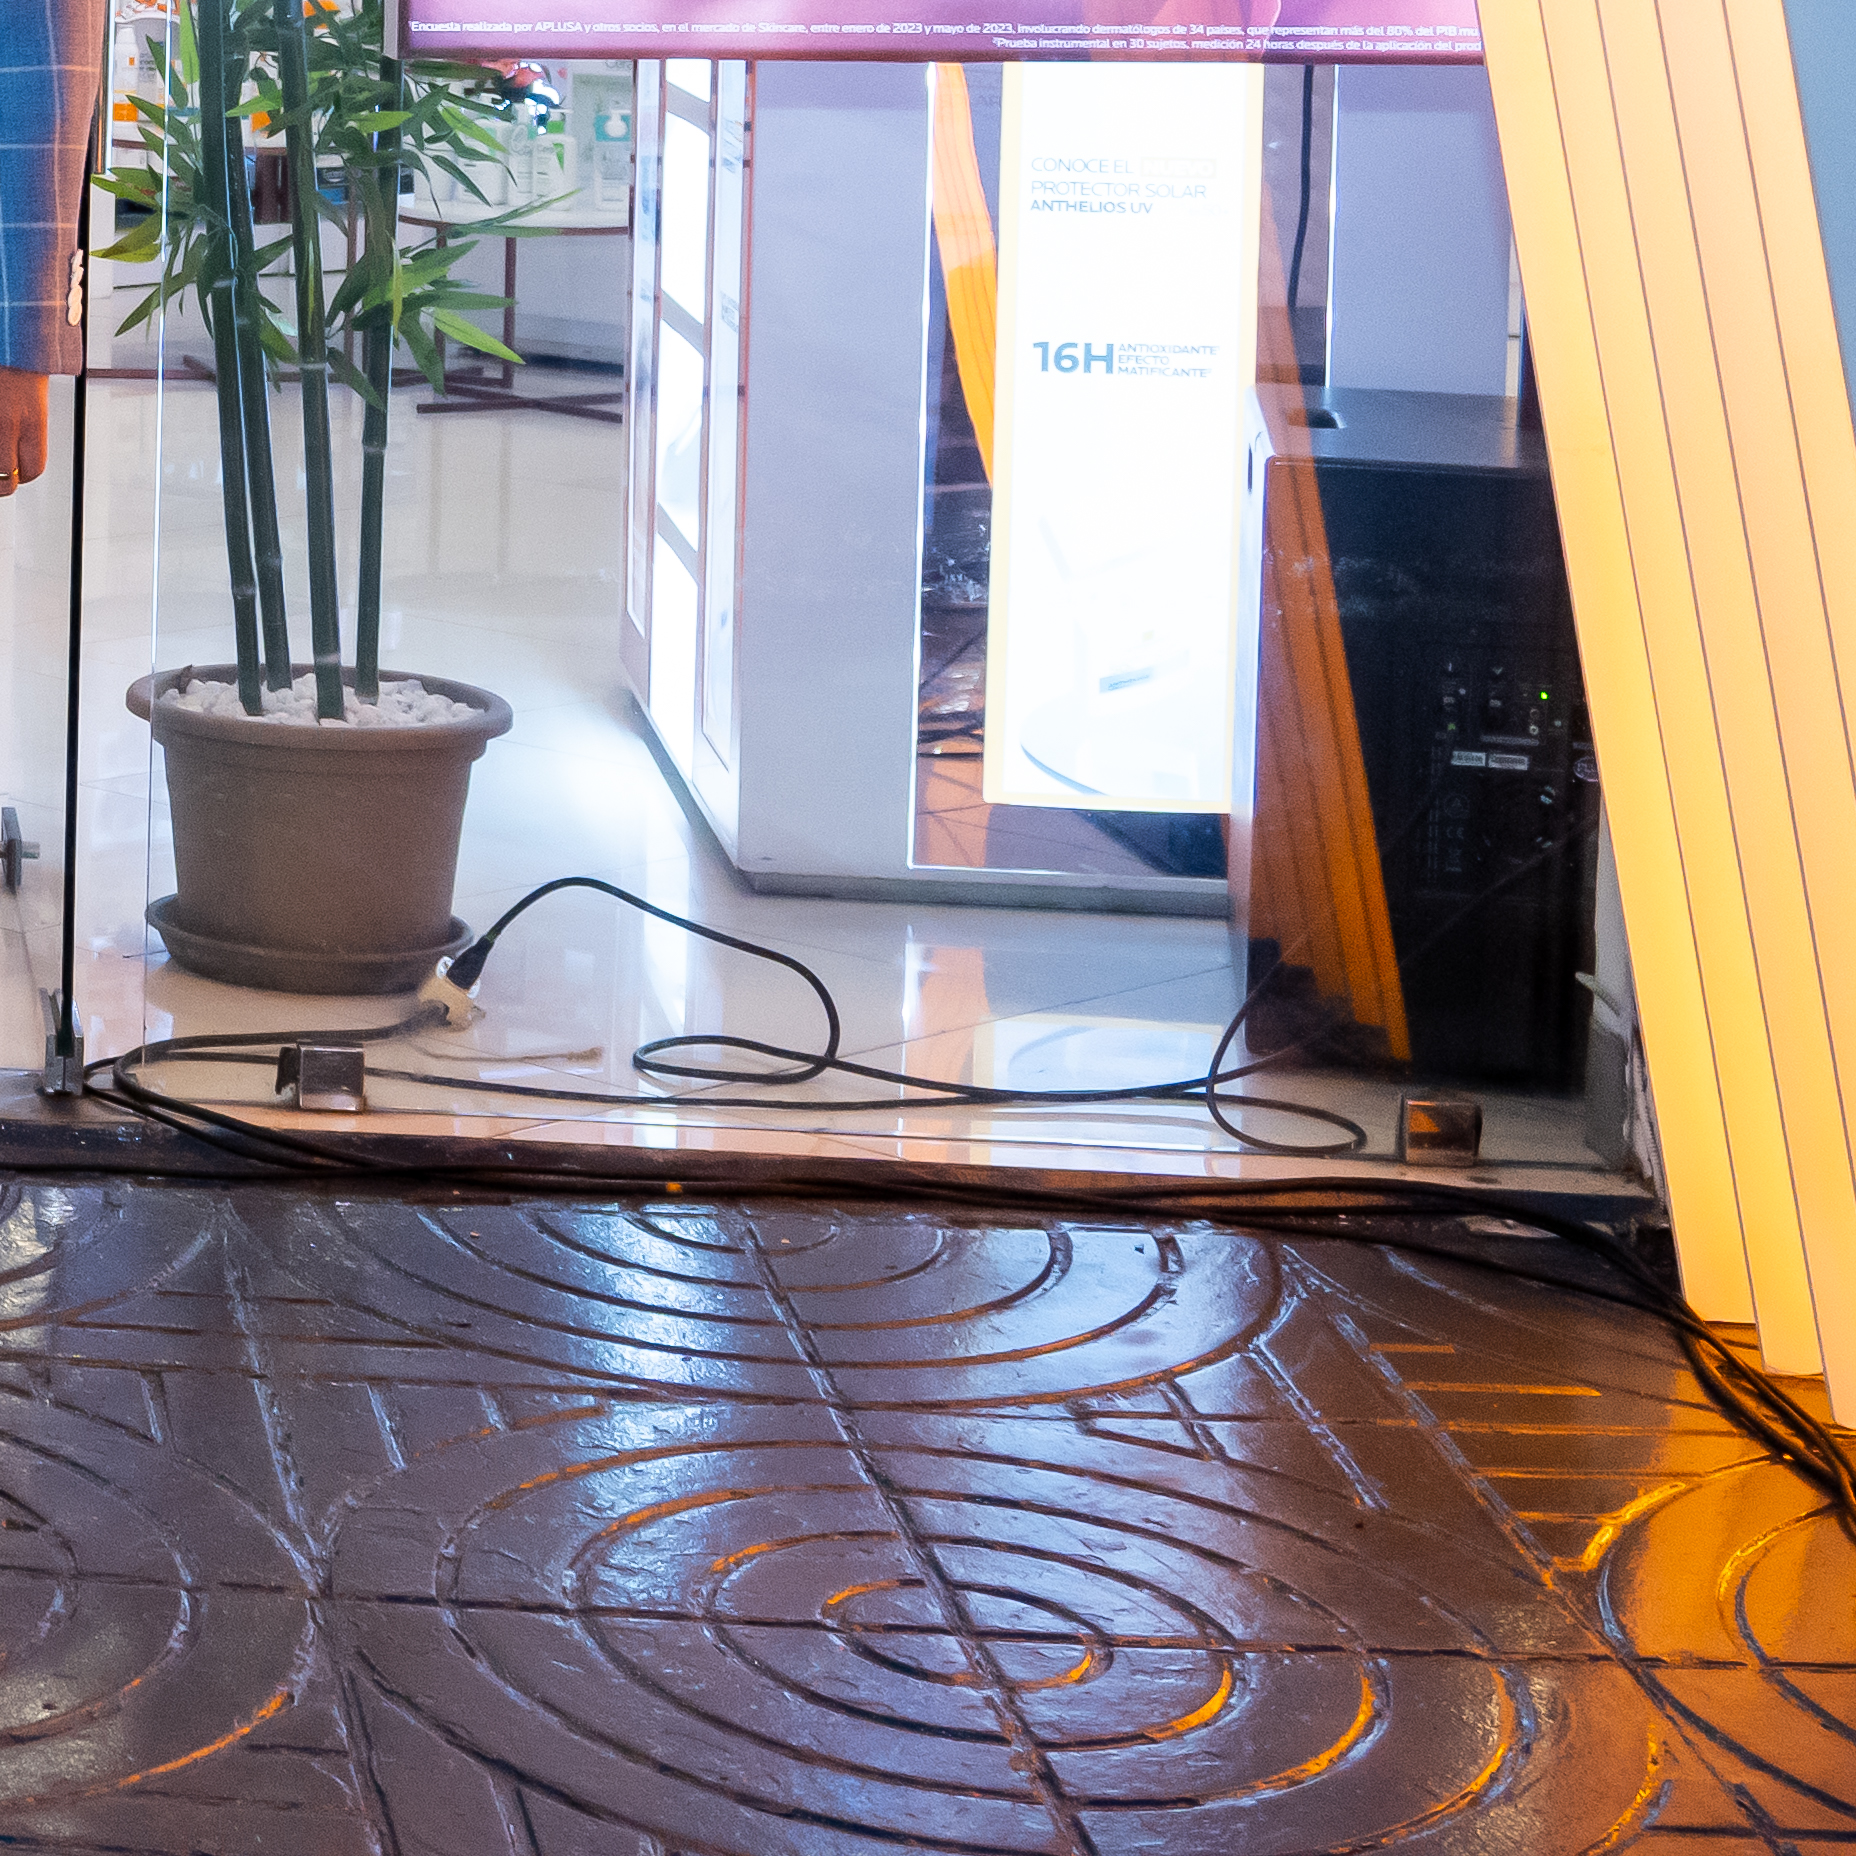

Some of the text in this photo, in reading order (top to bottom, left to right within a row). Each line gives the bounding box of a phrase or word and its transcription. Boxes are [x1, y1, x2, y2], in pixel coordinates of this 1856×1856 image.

[462, 21, 513, 32] realizada
[514, 23, 533, 34] por
[535, 21, 583, 33] APLUSA
[741, 23, 757, 33] de
[876, 23, 891, 33] de
[892, 23, 923, 34] 2023
[933, 25, 965, 35] mayo
[966, 24, 981, 34] de
[1172, 24, 1187, 35] de
[1189, 25, 1205, 35] 34
[1246, 27, 1270, 37] que
[1271, 26, 1339, 37] representan
[1366, 25, 1385, 36] del
[1415, 26, 1434, 36] del
[1039, 38, 1110, 49] instrumental
[1111, 40, 1127, 49] en
[1129, 38, 1145, 49] 30
[1191, 38, 1243, 49] medición
[1245, 39, 1261, 50] 24
[1263, 40, 1295, 50] horas
[1346, 40, 1361, 50] de
[1375, 39, 1432, 52] aplicación
[1433, 40, 1452, 51] del
[1031, 157, 1135, 174] CONOCE EL
[1031, 180, 1207, 199] PROTECTOR SOLAR
[1030, 199, 1127, 213] ANTHELIOS
[1032, 342, 1114, 374] 16H
